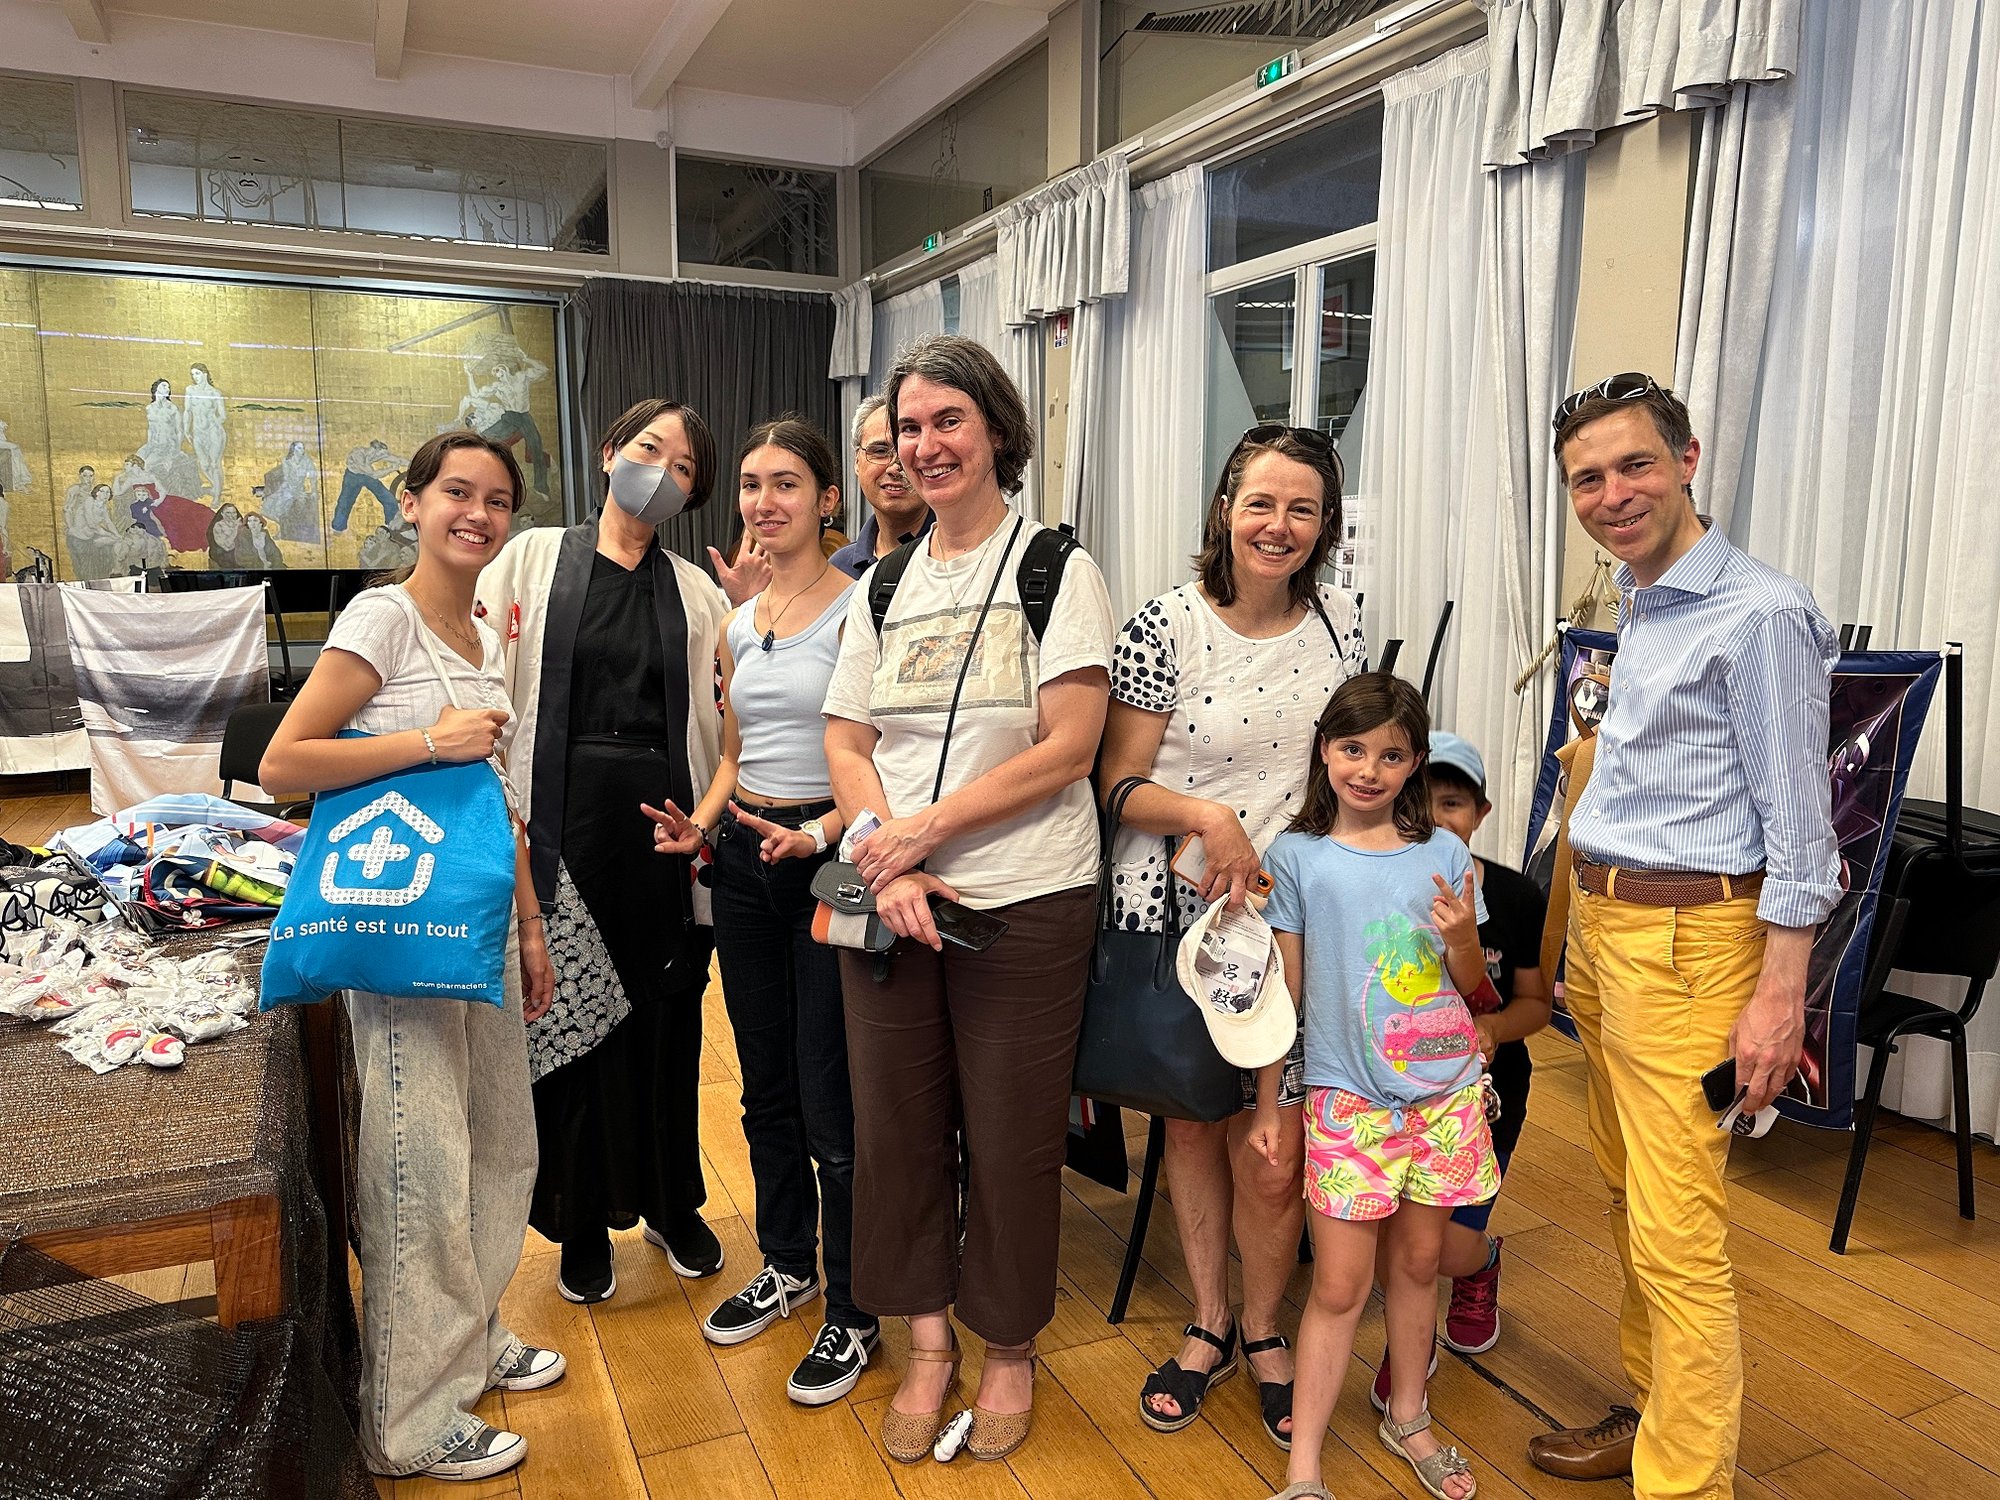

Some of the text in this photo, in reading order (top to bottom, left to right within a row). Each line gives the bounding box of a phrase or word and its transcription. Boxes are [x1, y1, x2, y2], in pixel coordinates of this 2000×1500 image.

[273, 915, 468, 941] La santé est un tout
[436, 982, 488, 990] pharmaciens
